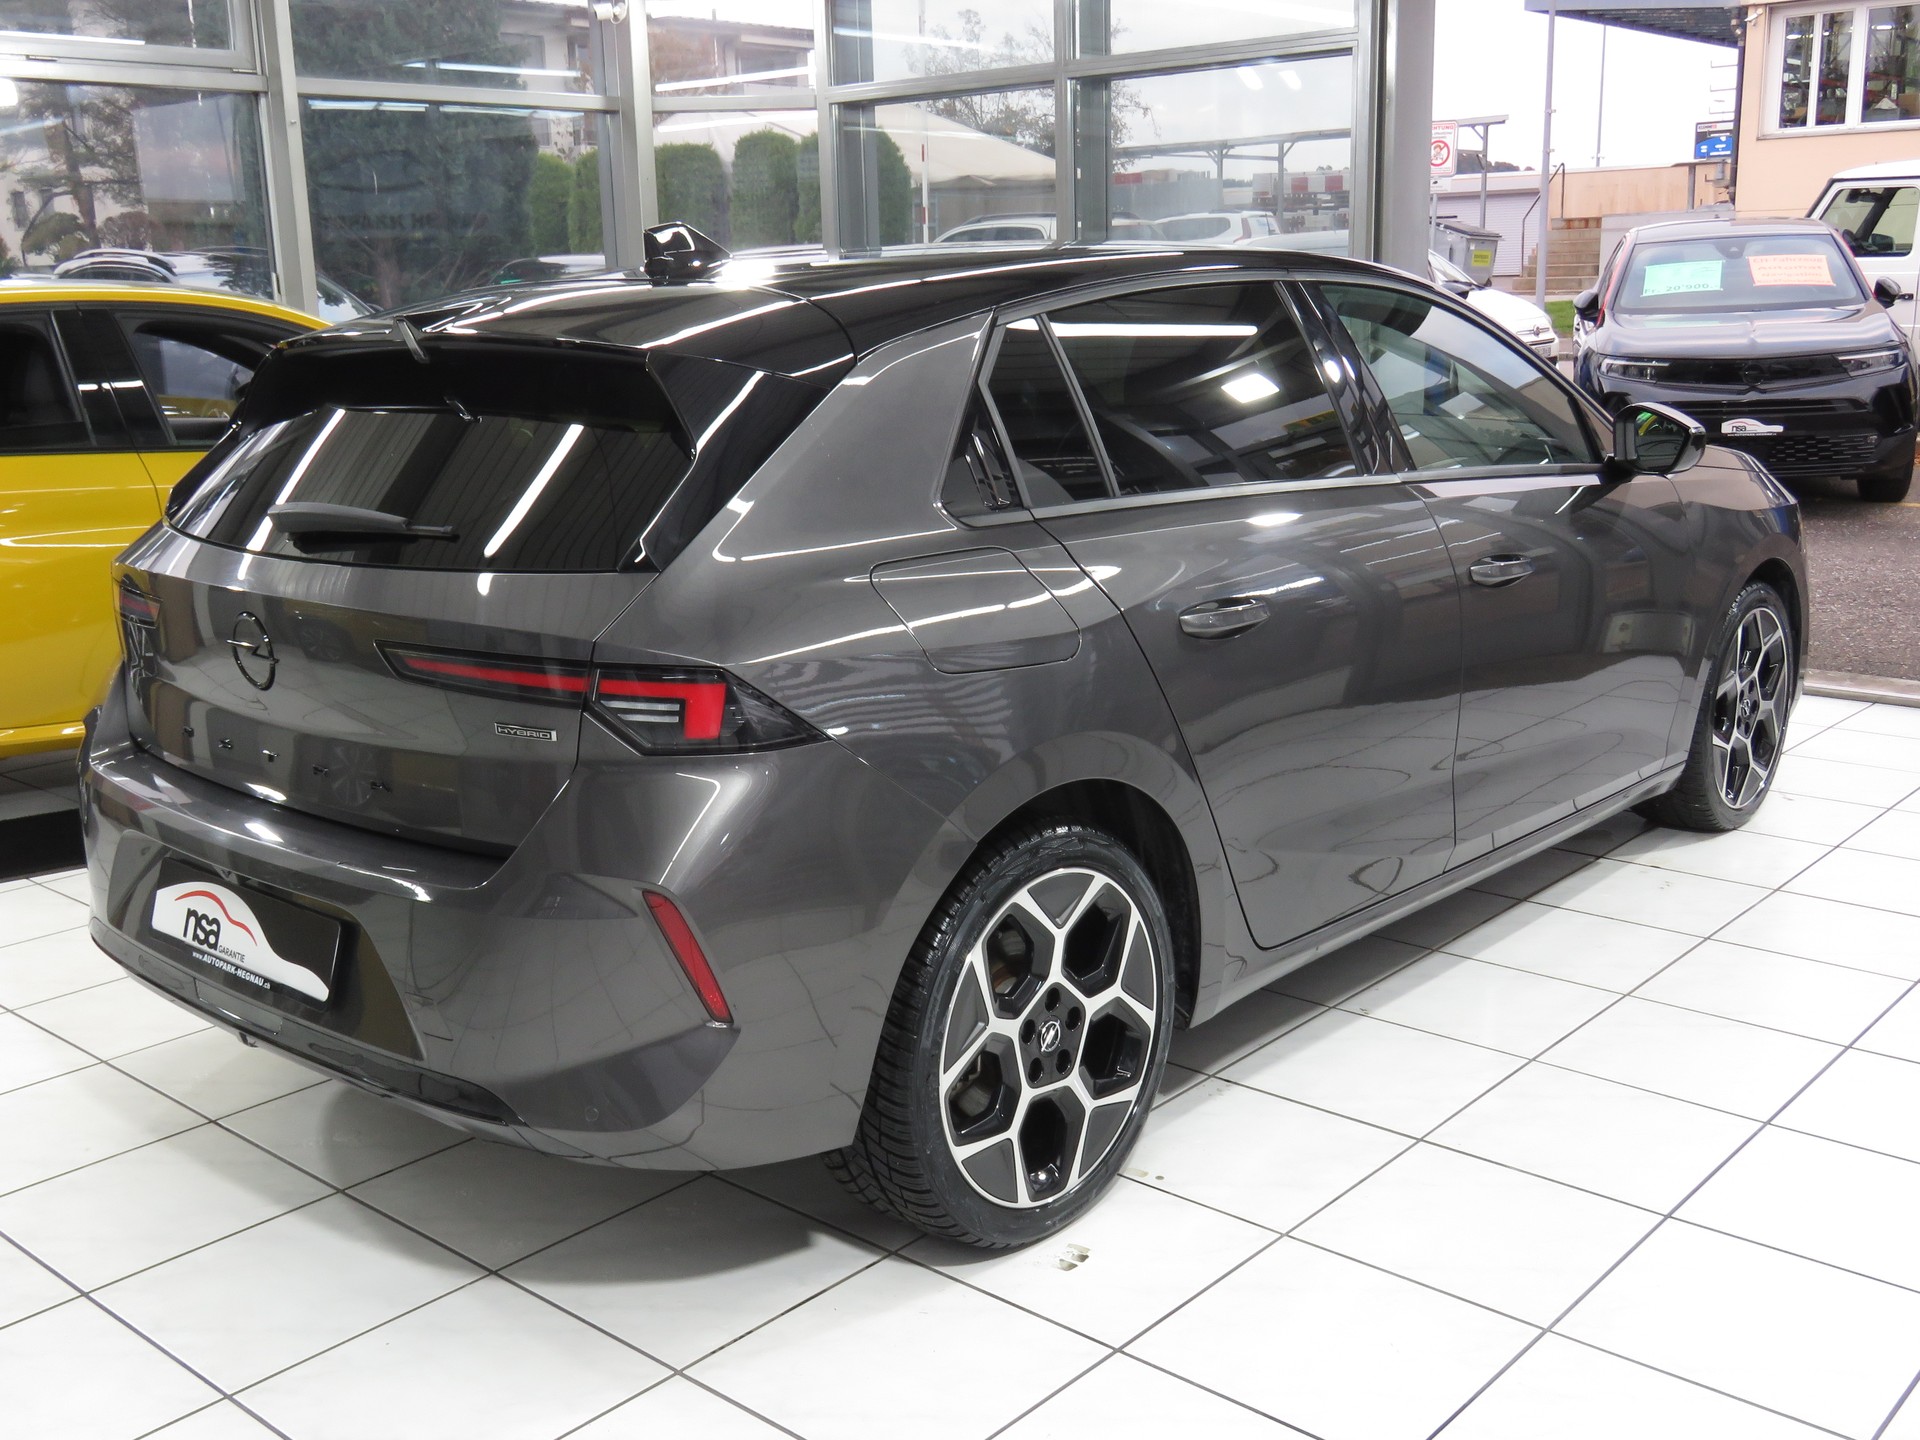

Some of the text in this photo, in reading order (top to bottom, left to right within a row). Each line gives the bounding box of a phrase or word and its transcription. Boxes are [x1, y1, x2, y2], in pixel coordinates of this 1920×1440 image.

[497, 726, 550, 739] HYBRID
[183, 907, 221, 951] nsa
[218, 944, 246, 963] GARANTIE
[192, 951, 271, 990] www.AUTOPARK-HEGNAU.ch
